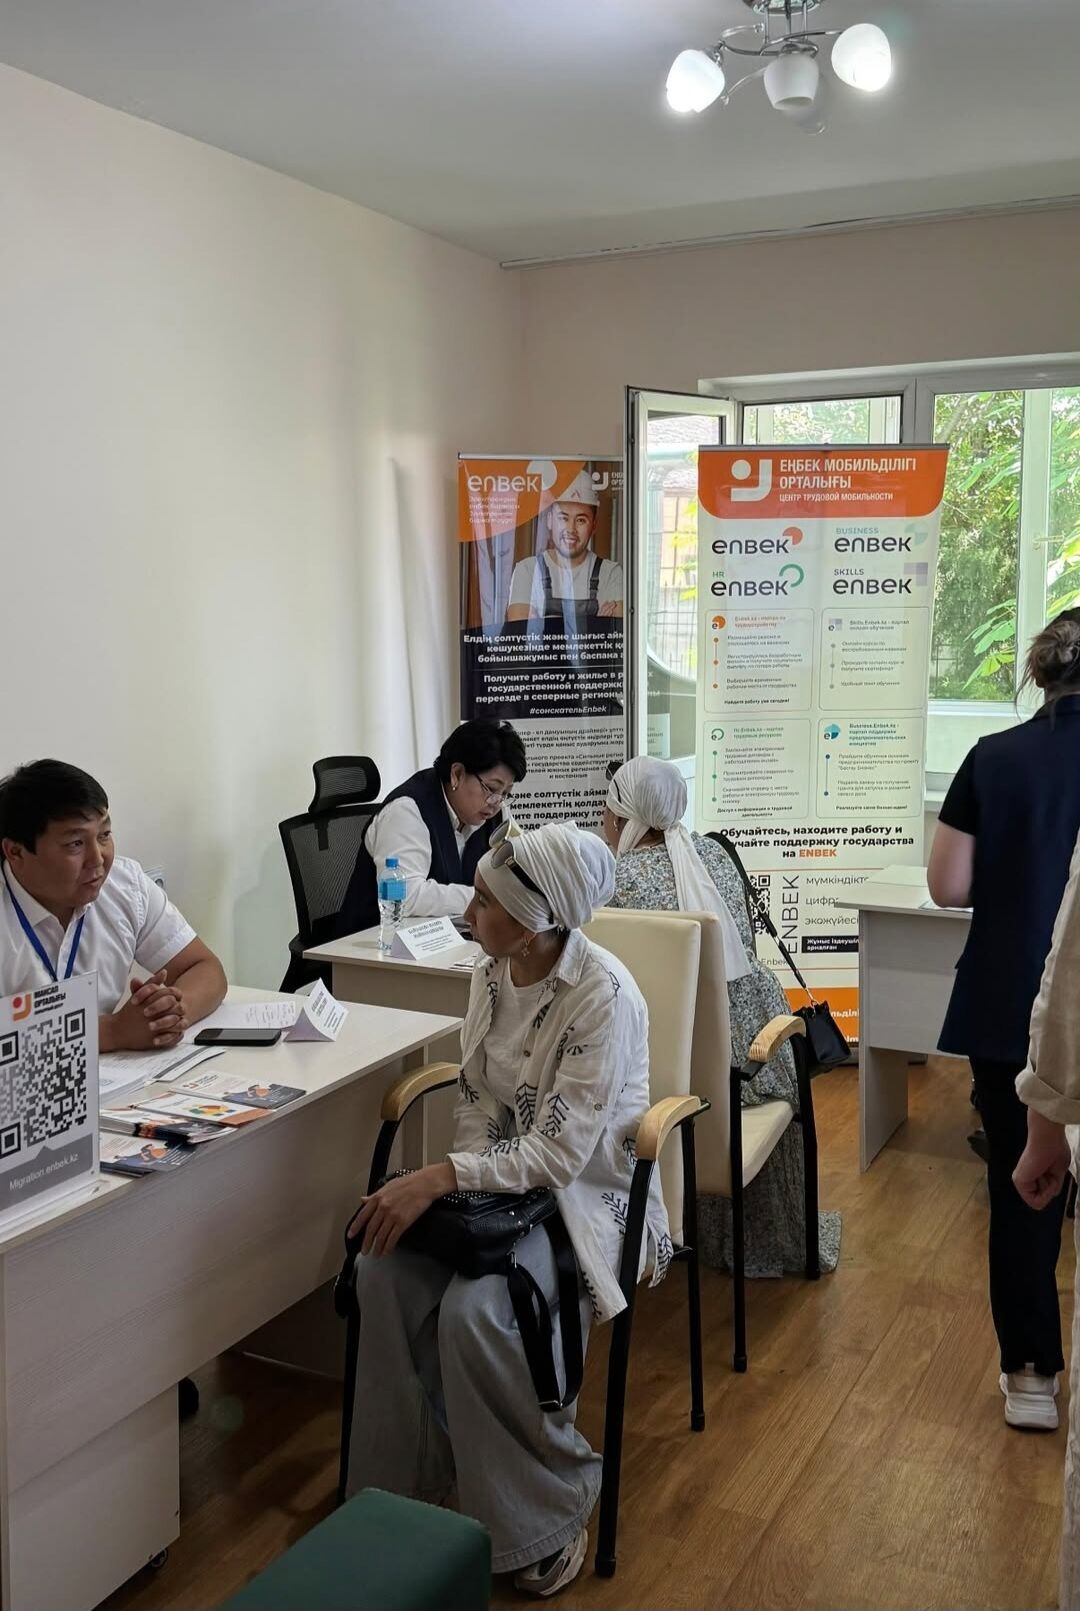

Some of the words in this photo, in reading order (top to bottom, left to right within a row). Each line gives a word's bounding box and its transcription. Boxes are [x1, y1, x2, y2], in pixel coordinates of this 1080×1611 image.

[780, 458, 819, 474] ЕҢБЕК
[824, 457, 916, 473] МОБИЛЬДІЛІГІ
[780, 476, 851, 489] ОРТАЛЫҒЫ
[780, 494, 802, 502] ЦЕНТР
[804, 492, 840, 502] ТРУДОВОЙ
[841, 492, 893, 501] МОБИЛЬНОСТИ
[464, 634, 492, 644] Елдің
[572, 632, 605, 640] шығыс
[552, 640, 613, 650] мемлекеттік
[580, 652, 618, 660] баспана
[484, 674, 530, 684] Получите
[532, 672, 566, 682] работу
[487, 682, 571, 694] государственной
[475, 694, 522, 704] переезде
[532, 692, 580, 702] северные
[534, 788, 582, 798] солтүстік
[534, 810, 590, 820] поддержку
[720, 828, 790, 839] Обучайтесь,
[793, 826, 848, 836] находите
[851, 825, 892, 836] работу
[732, 838, 770, 848] учайте
[773, 837, 840, 848] поддержку
[842, 836, 914, 848] государства
[799, 849, 837, 858] ENBEK
[782, 876, 799, 954] ENBEK
